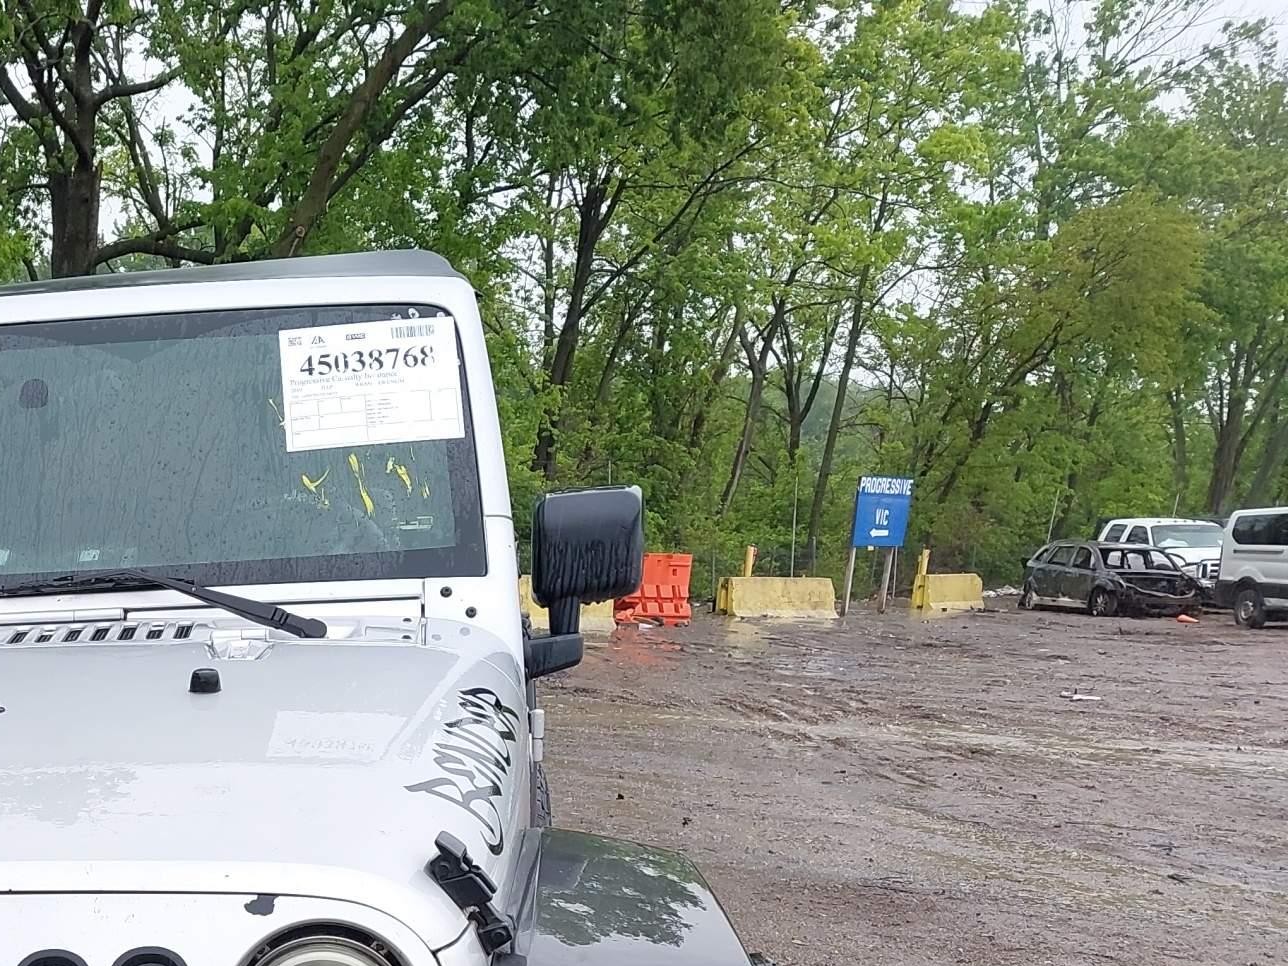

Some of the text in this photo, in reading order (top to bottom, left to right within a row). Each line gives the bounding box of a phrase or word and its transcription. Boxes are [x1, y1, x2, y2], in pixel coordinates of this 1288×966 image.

[300, 346, 435, 376] 45038768
[859, 476, 914, 496] PROGRESSIVE
[875, 508, 890, 525] VIC
